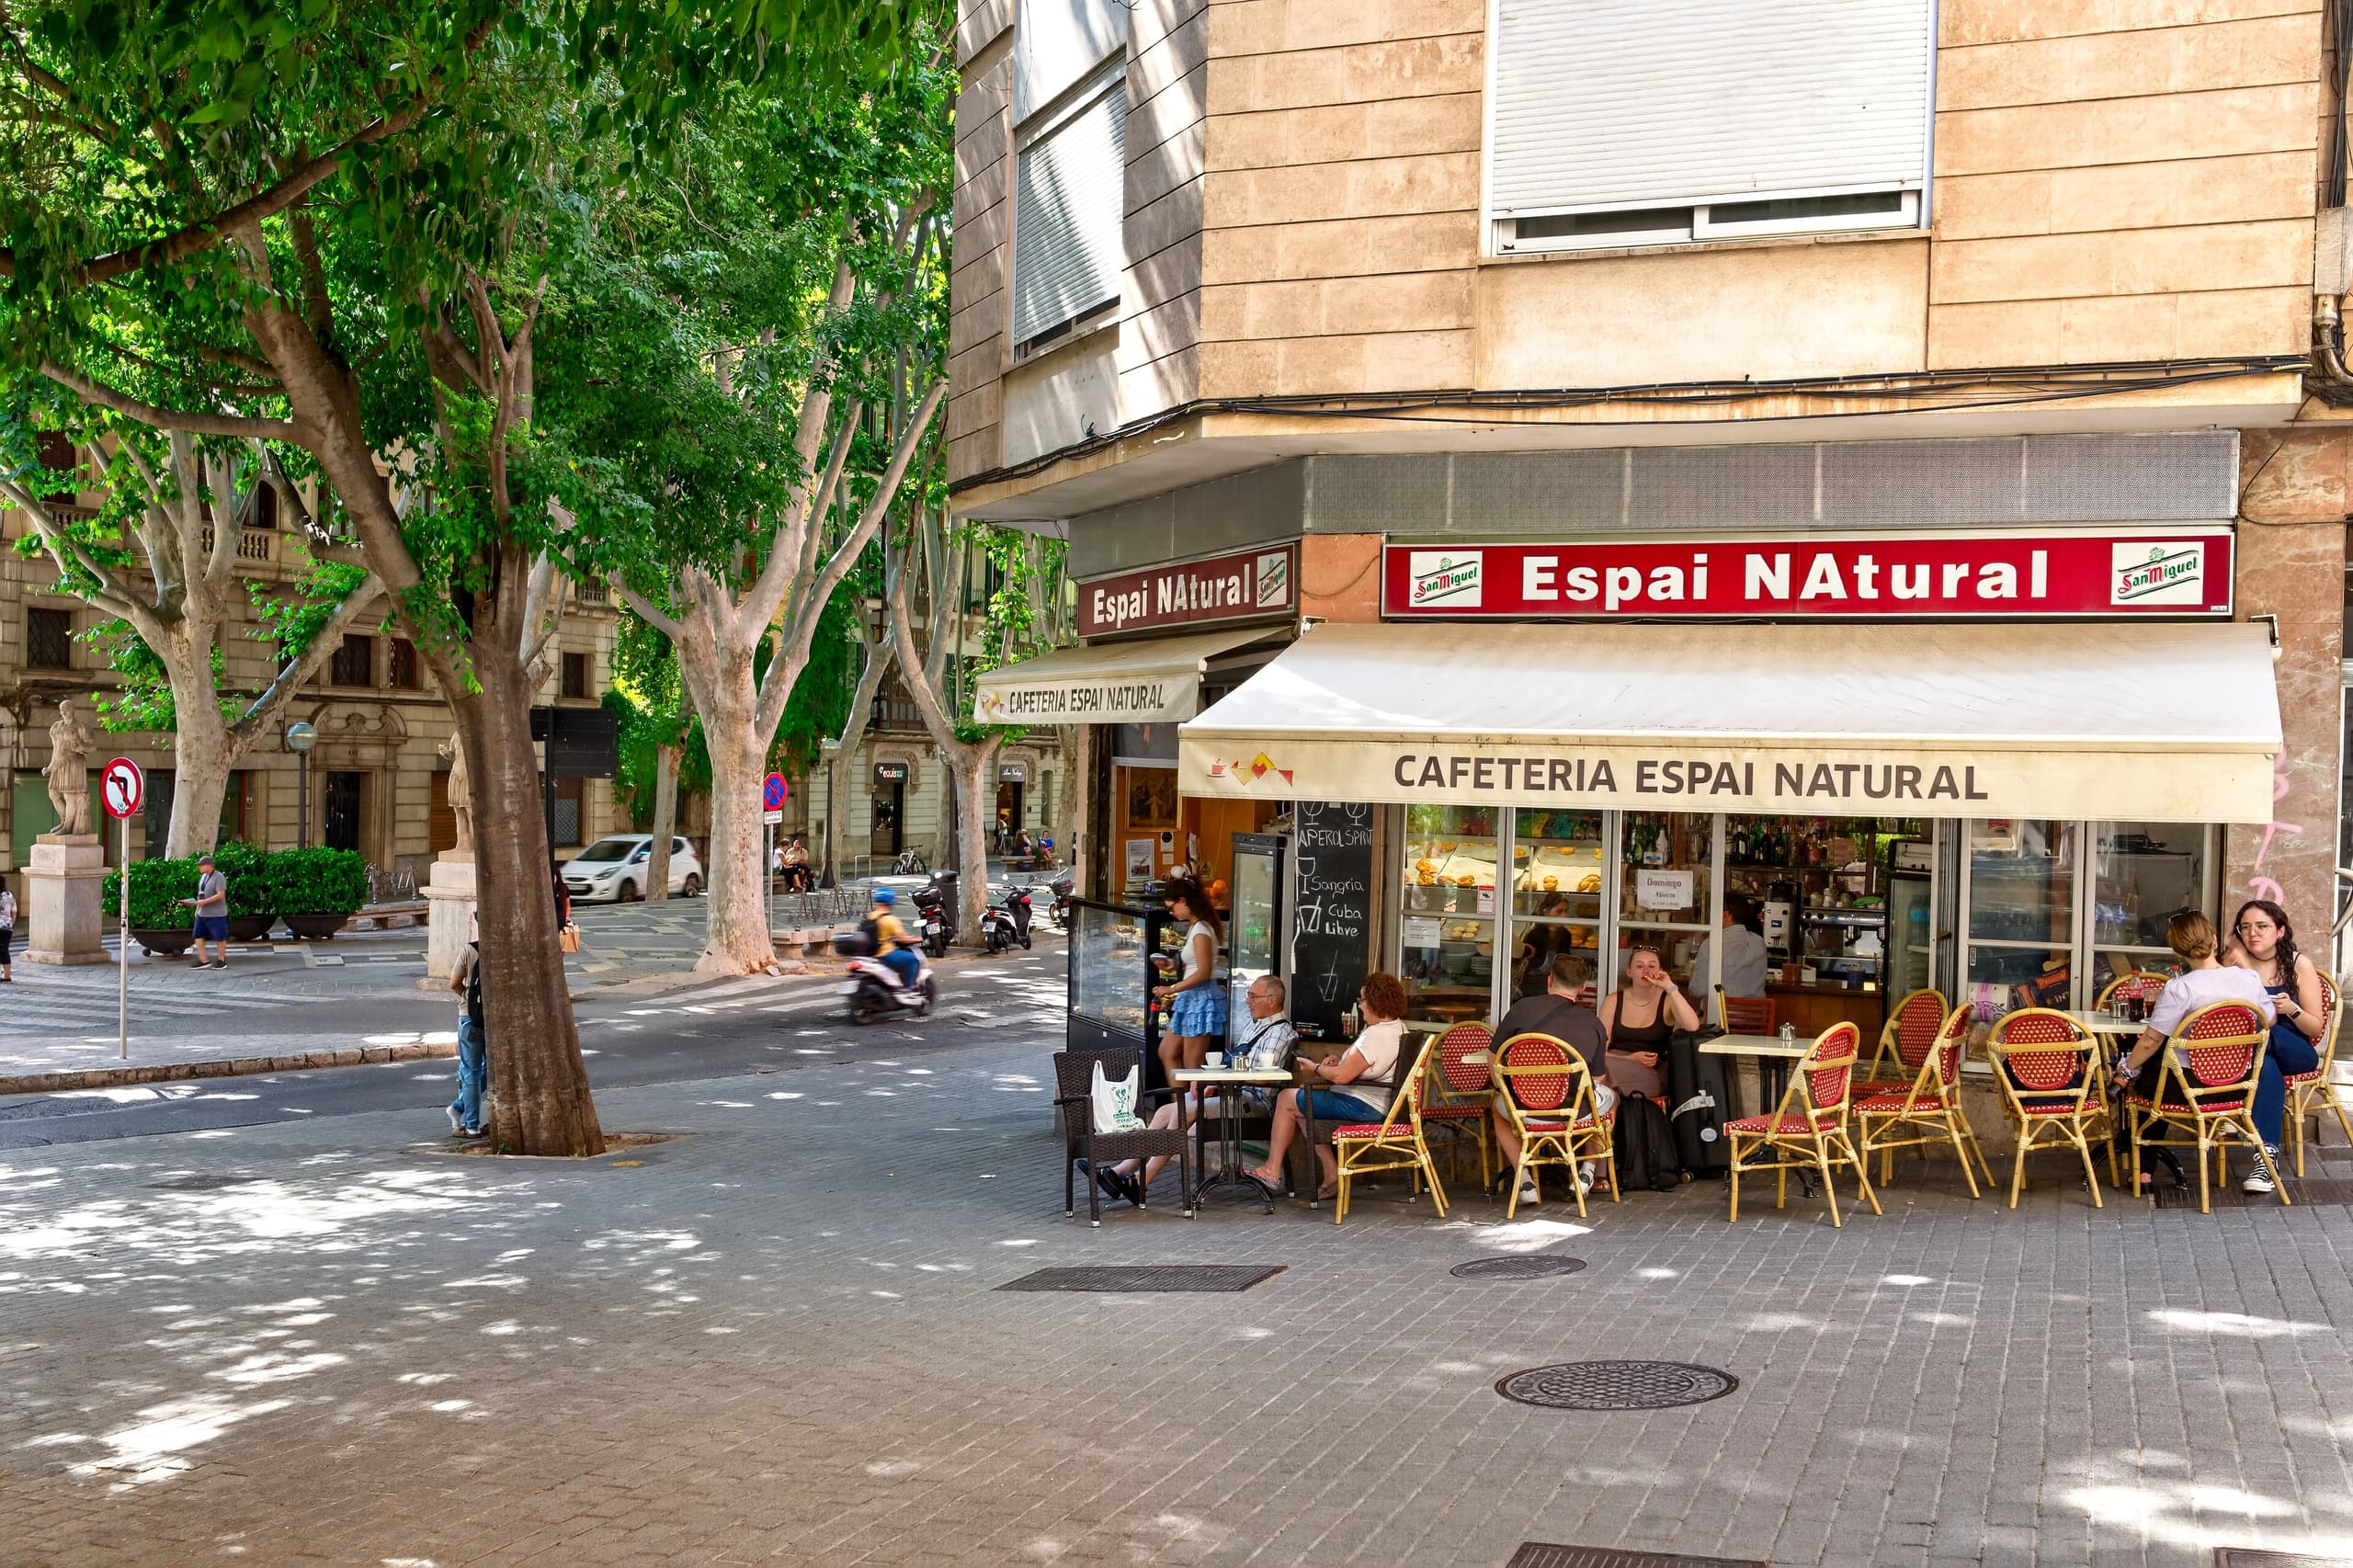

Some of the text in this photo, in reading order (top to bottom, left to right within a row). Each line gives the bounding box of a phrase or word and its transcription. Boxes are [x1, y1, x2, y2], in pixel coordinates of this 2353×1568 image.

[1093, 563, 1250, 629] Espai NAtural
[1522, 550, 2048, 611] Espai NAtural
[1009, 684, 1165, 714] CAFETERIA ESPAI NATURAL
[1393, 754, 1989, 801] CAFETERIA ESPAI NATURAL
[1310, 875, 1365, 900] Sangria
[1328, 903, 1362, 920] Cuba
